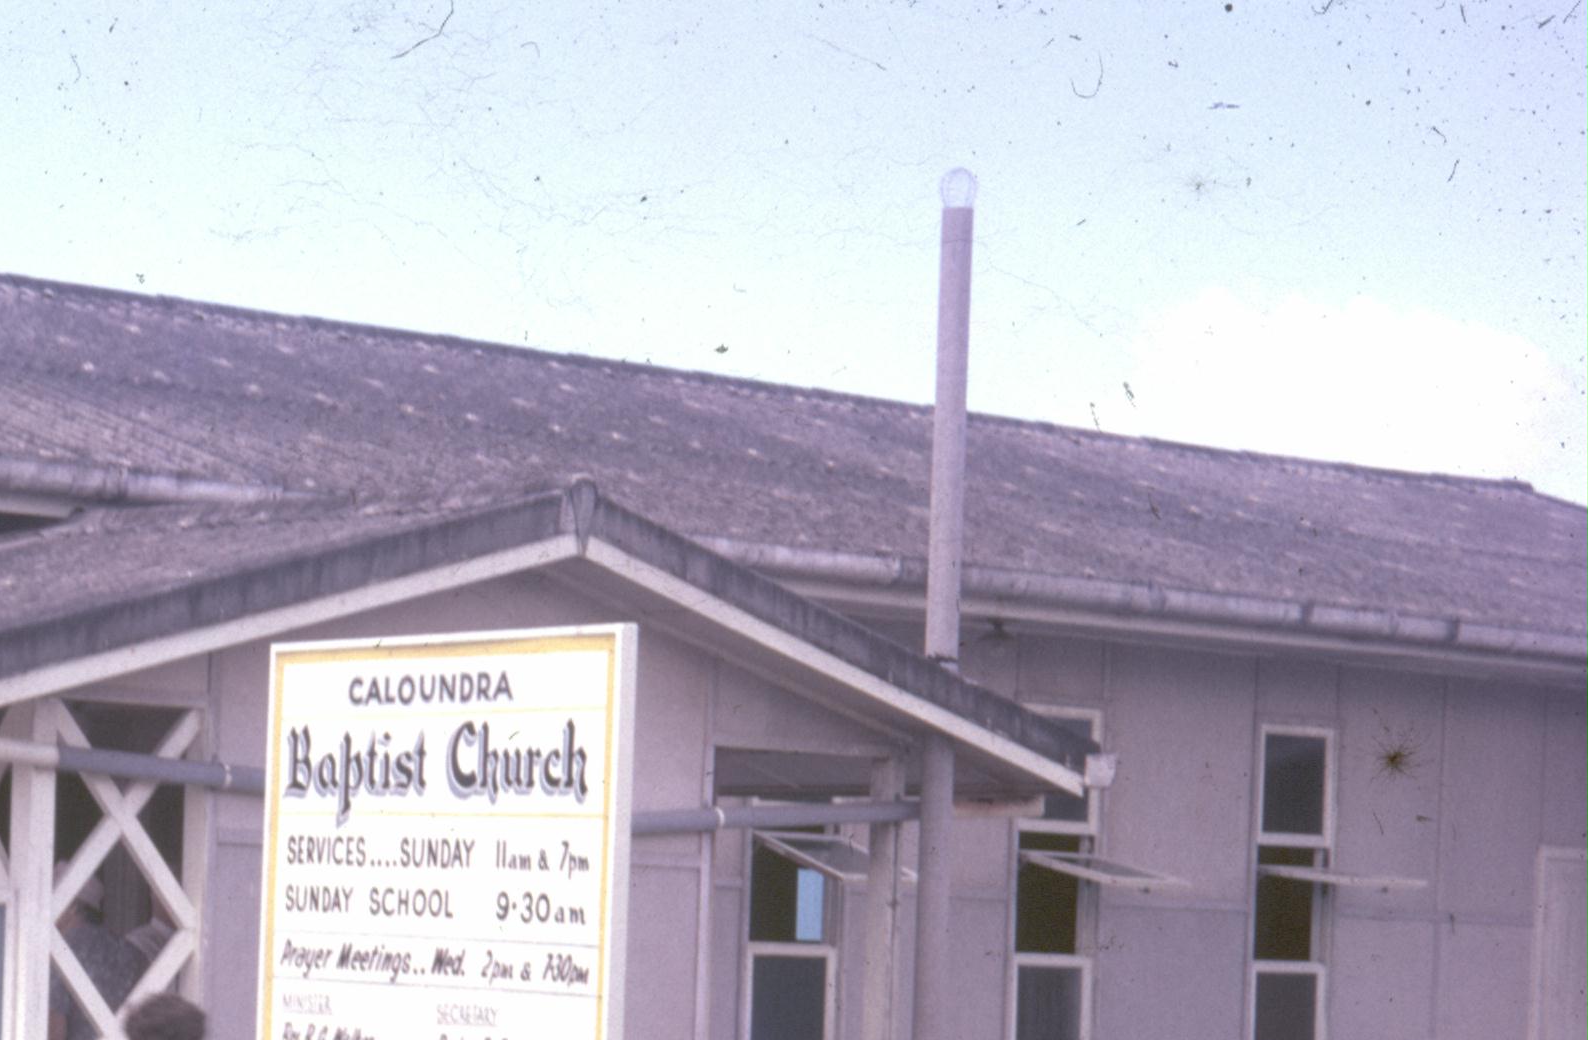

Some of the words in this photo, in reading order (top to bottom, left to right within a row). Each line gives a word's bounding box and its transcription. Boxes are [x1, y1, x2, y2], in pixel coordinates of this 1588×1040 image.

[348, 671, 513, 706] CALOUNDRA
[285, 725, 427, 825] Baptist
[447, 719, 588, 804] Church
[496, 839, 532, 871] 11am
[538, 848, 550, 871] &
[559, 840, 590, 880] 7pm
[285, 884, 354, 913] SUNDAY
[369, 886, 453, 918] SCHOOL
[280, 938, 333, 979] Prayer
[430, 948, 466, 977] Wed.
[481, 949, 513, 985] 2pm
[520, 961, 531, 982] &
[436, 1003, 499, 1026] SECRETARY
